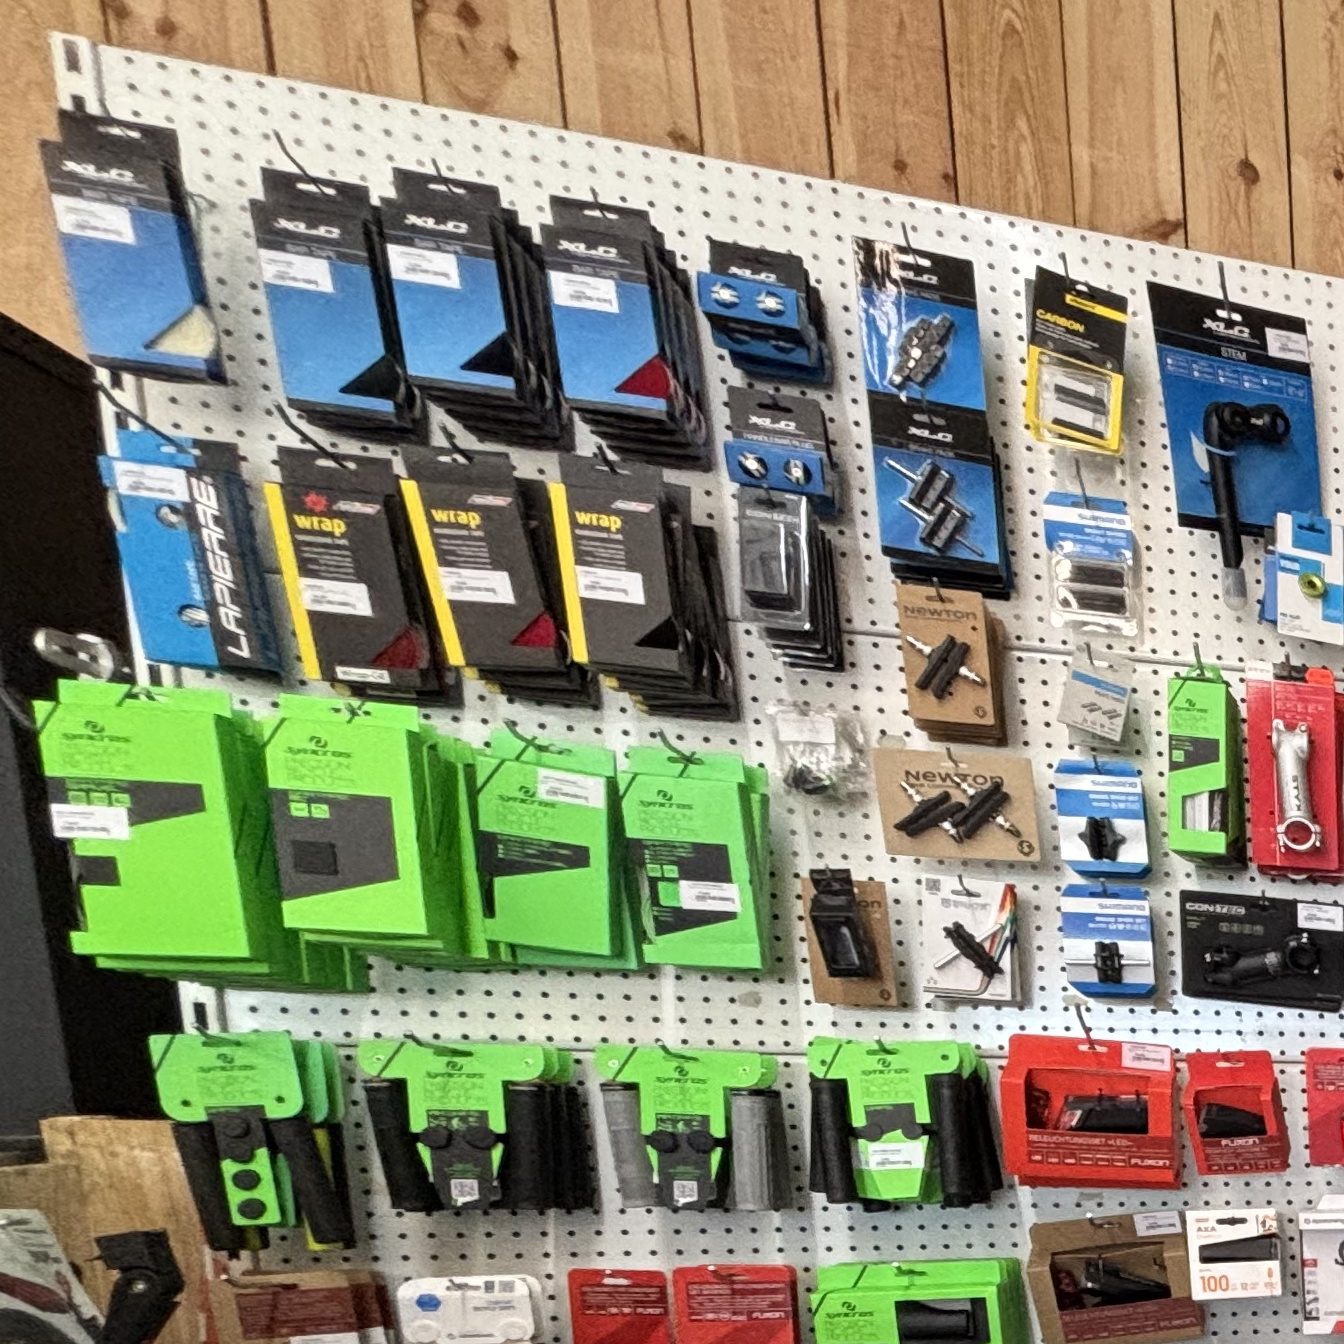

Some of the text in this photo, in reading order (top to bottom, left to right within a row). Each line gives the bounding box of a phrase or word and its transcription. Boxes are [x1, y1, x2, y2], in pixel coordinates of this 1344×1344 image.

[1036, 308, 1085, 333] CARBON
[1203, 318, 1250, 339] XLC
[293, 513, 347, 537] wrap
[431, 508, 482, 529] wrap
[574, 509, 623, 530] wrap
[1186, 903, 1246, 916] CONTEC
[1195, 1225, 1218, 1236] AXA
[1199, 1274, 1230, 1293] 100
